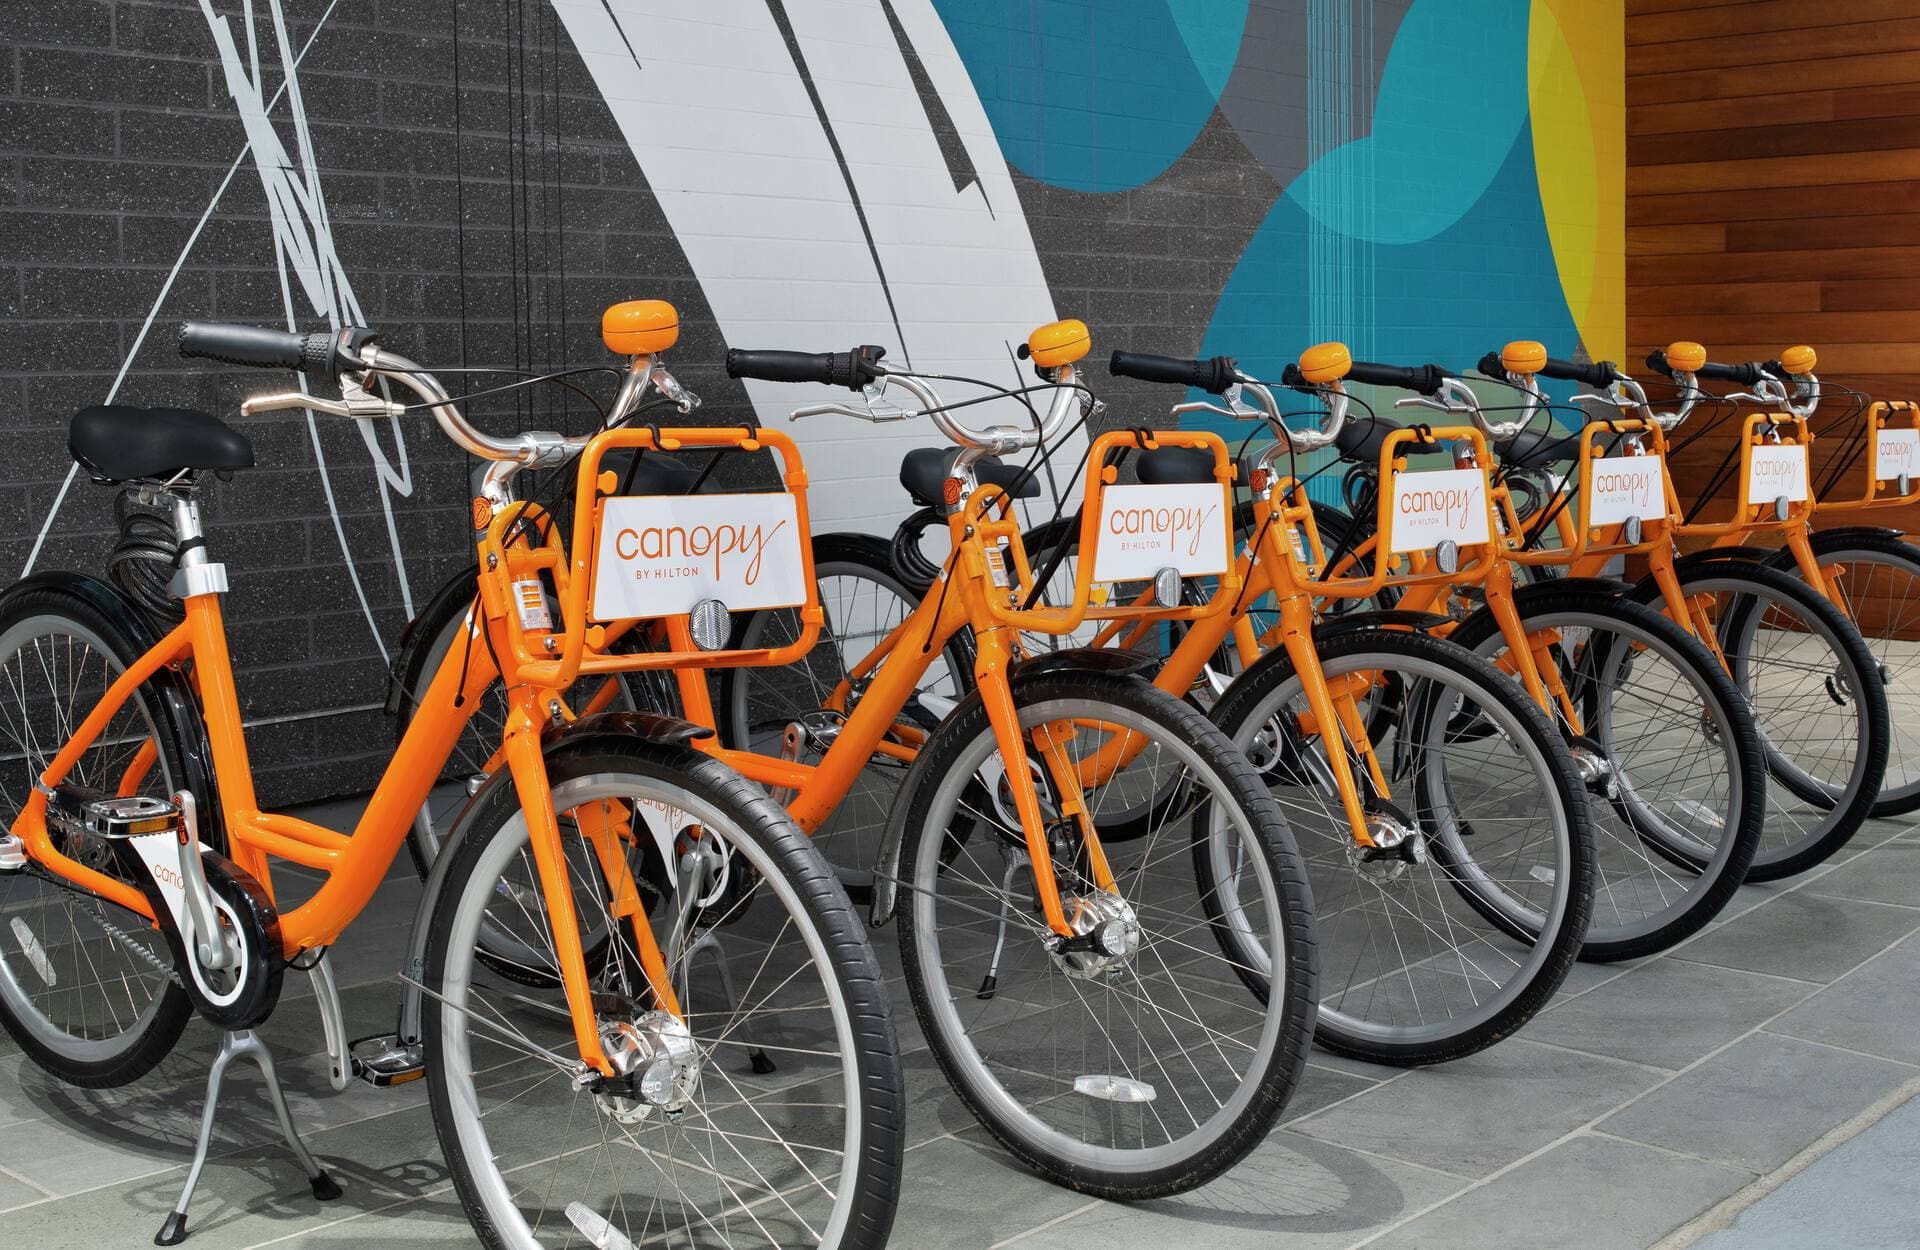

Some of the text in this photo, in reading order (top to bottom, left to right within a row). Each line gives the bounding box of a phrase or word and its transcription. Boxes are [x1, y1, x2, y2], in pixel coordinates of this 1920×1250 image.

[1401, 486, 1479, 529] canopy
[1597, 470, 1658, 507] canopy
[1111, 504, 1217, 556] canopy
[1121, 541, 1161, 550] BY HILTON
[616, 519, 786, 586] canopy
[636, 567, 699, 580] BY HILTON
